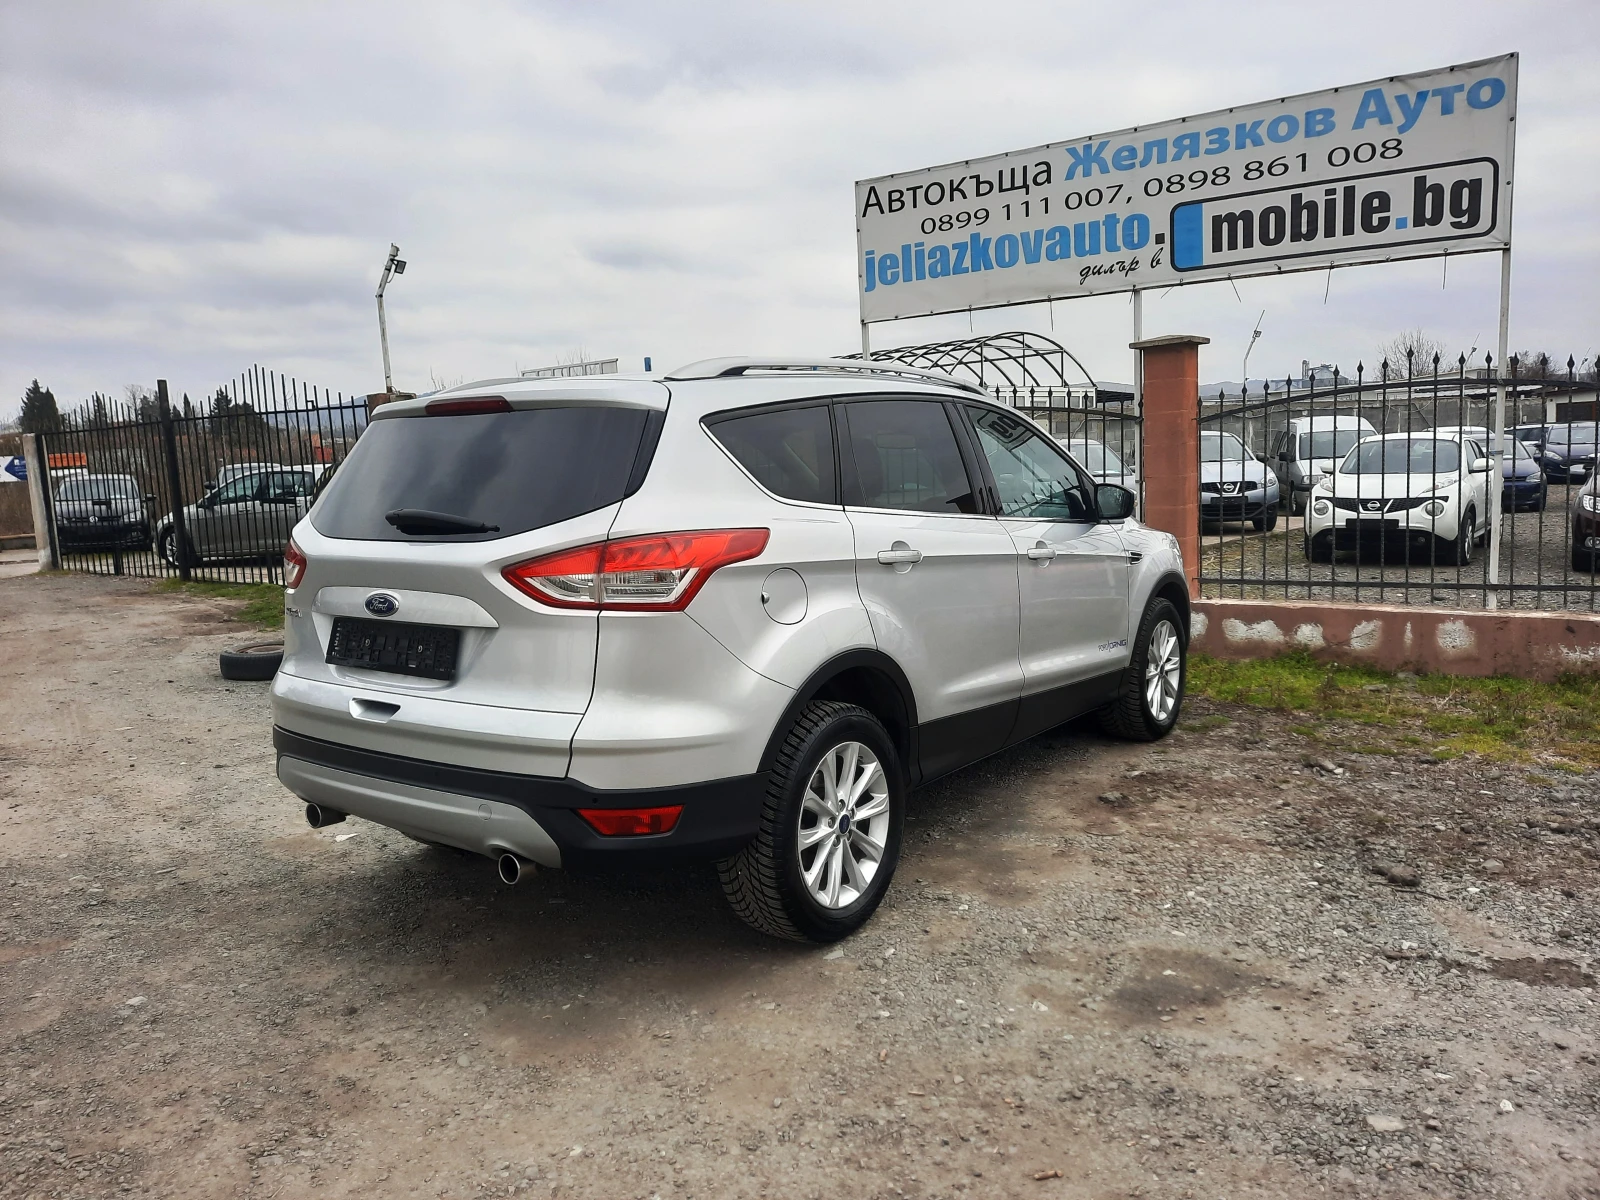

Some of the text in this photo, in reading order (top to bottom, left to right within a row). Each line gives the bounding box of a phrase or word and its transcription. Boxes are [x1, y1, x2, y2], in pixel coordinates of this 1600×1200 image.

[861, 77, 1506, 218] Автокъща Желязков Ауто
[920, 137, 1404, 235] 0899 111 007, 0898 861 008
[1211, 174, 1483, 254] mobile.bg
[1079, 256, 1141, 286] дилър
